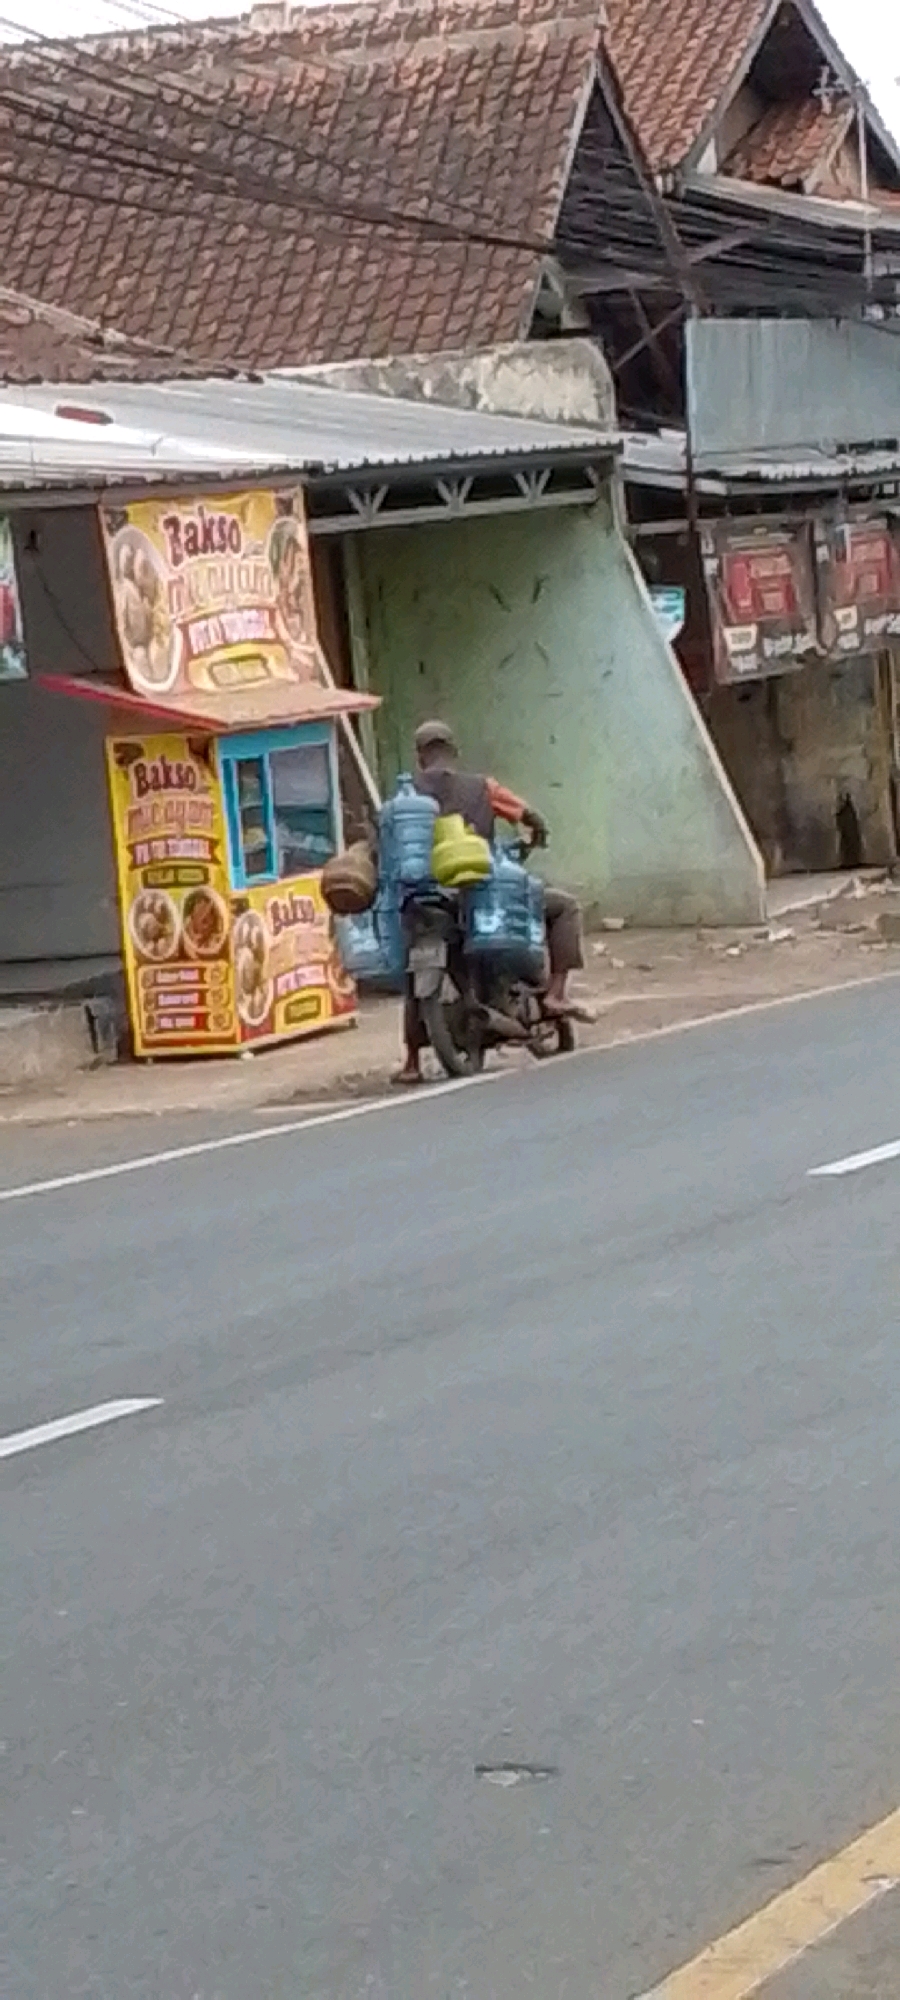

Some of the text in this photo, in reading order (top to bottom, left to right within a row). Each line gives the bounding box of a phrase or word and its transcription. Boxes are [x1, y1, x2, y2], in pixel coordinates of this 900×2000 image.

[163, 505, 242, 567] Bakso
[134, 755, 196, 798] Bakso
[270, 890, 315, 936] Bakso
